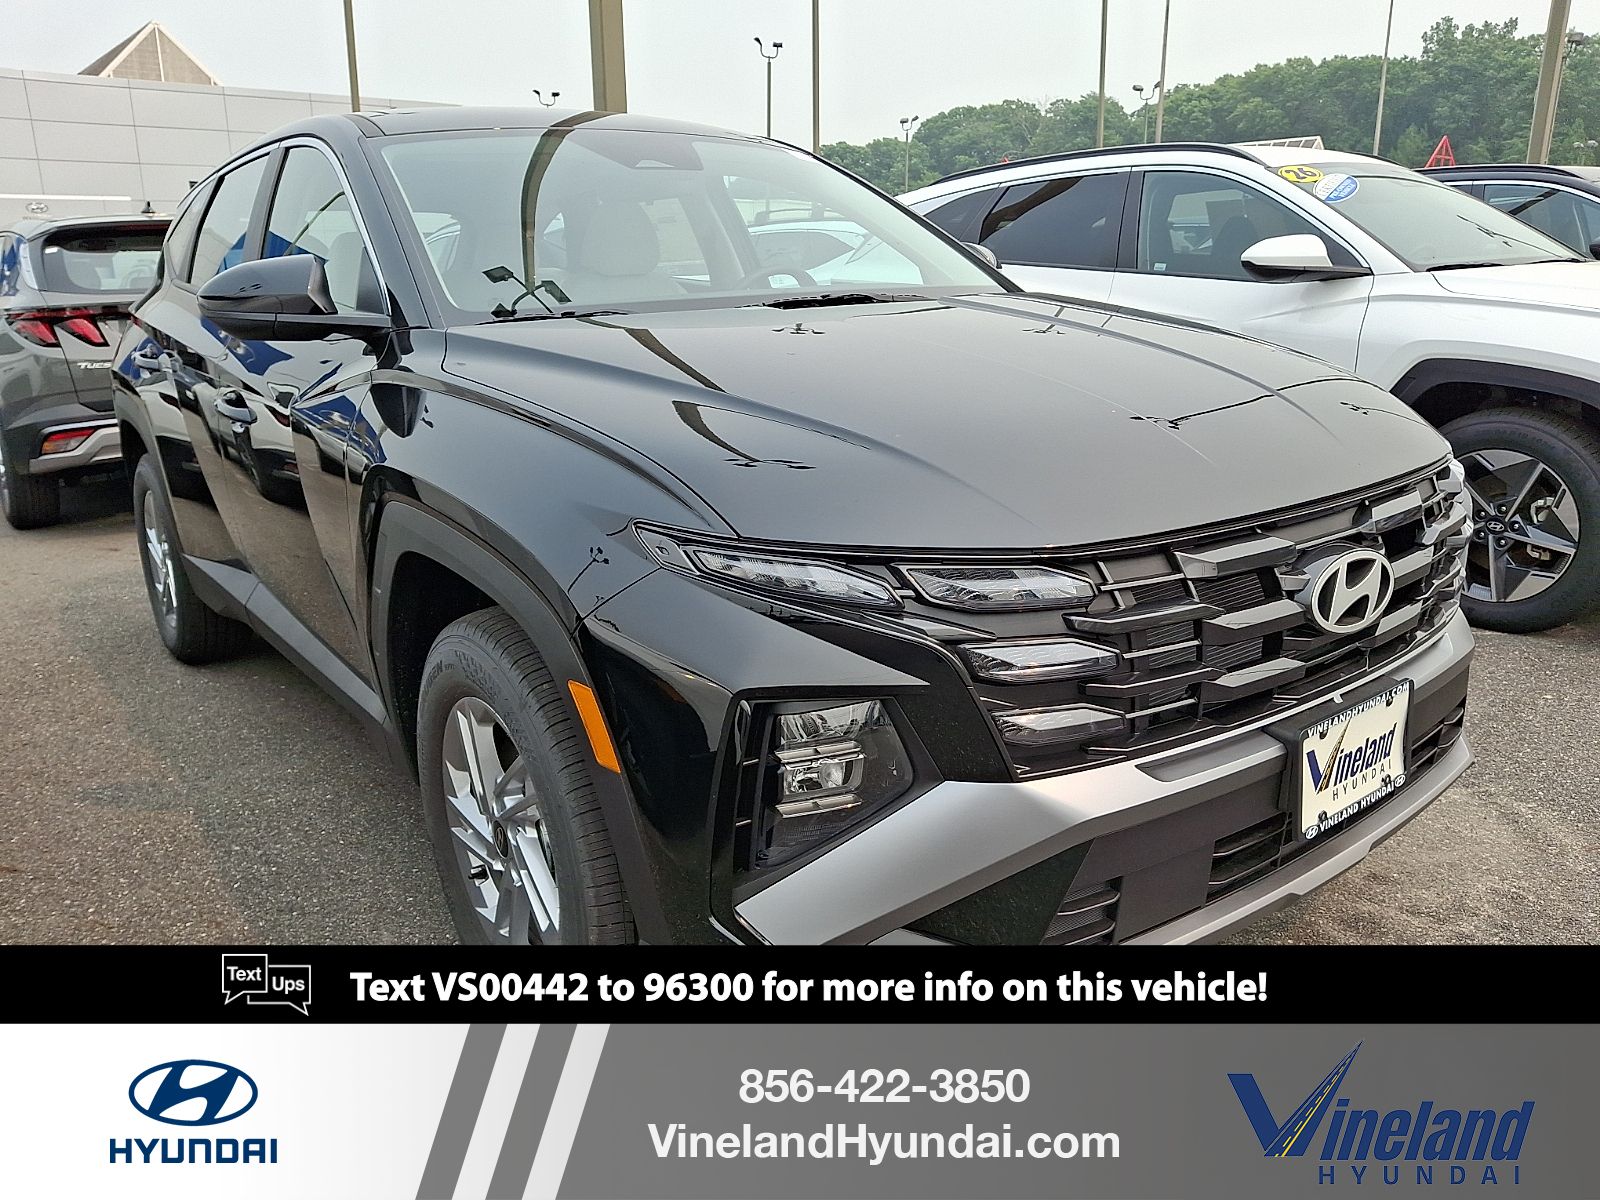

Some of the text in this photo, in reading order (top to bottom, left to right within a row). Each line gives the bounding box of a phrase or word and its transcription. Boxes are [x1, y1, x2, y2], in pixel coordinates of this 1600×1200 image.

[1284, 167, 1317, 180] 26
[1307, 681, 1409, 738] VINELANDHYUNDAI.COM
[1306, 718, 1397, 795] Vineland
[1332, 759, 1392, 801] HYUNDAI
[1319, 782, 1395, 832] VINELAND HYUNDAI
